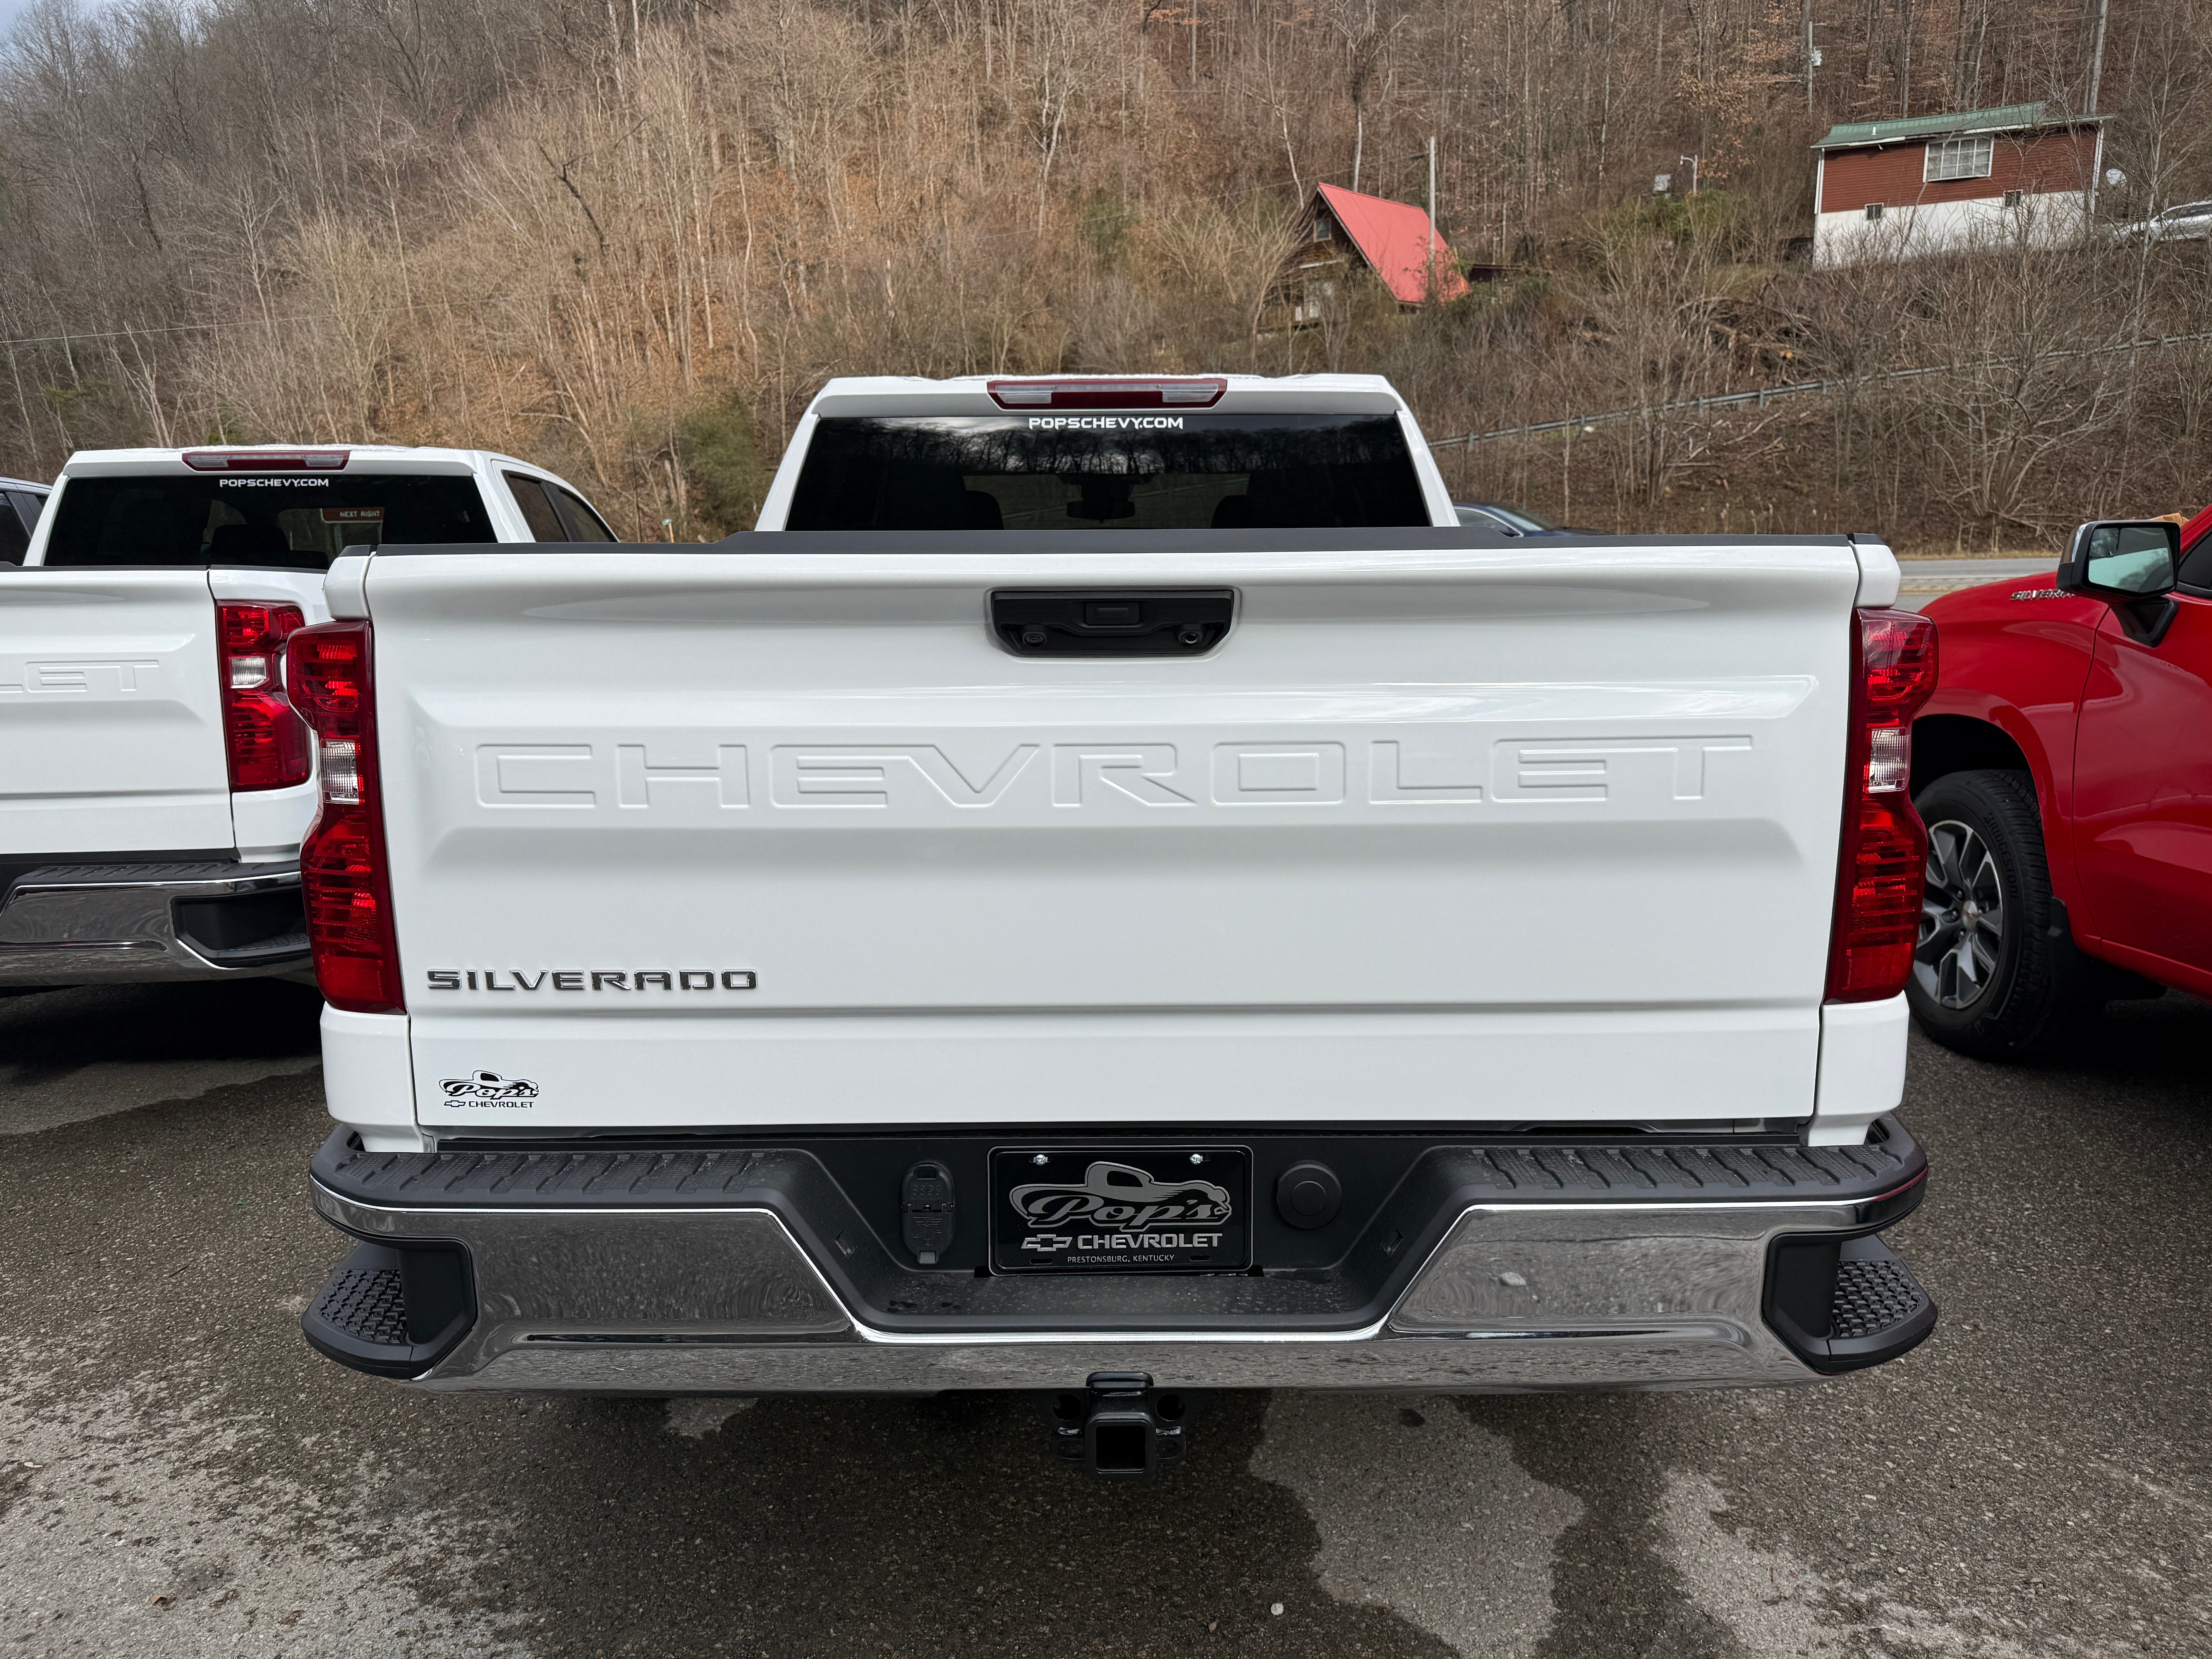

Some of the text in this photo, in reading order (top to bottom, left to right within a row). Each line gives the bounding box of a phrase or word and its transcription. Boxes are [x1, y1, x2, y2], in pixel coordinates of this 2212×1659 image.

[1029, 416, 1183, 430] POPSCHEVY.COM
[219, 478, 329, 487] POPSCHEVY.COM
[474, 734, 1753, 809] CHEVROLET
[426, 969, 759, 990] SILVERADO
[446, 1082, 535, 1099] Pop's
[1028, 1195, 1219, 1226] Pop's
[1077, 1233, 1223, 1250] CHEVROLET
[1067, 1254, 1175, 1264] PRESTONSBURG, KENTUCKY
